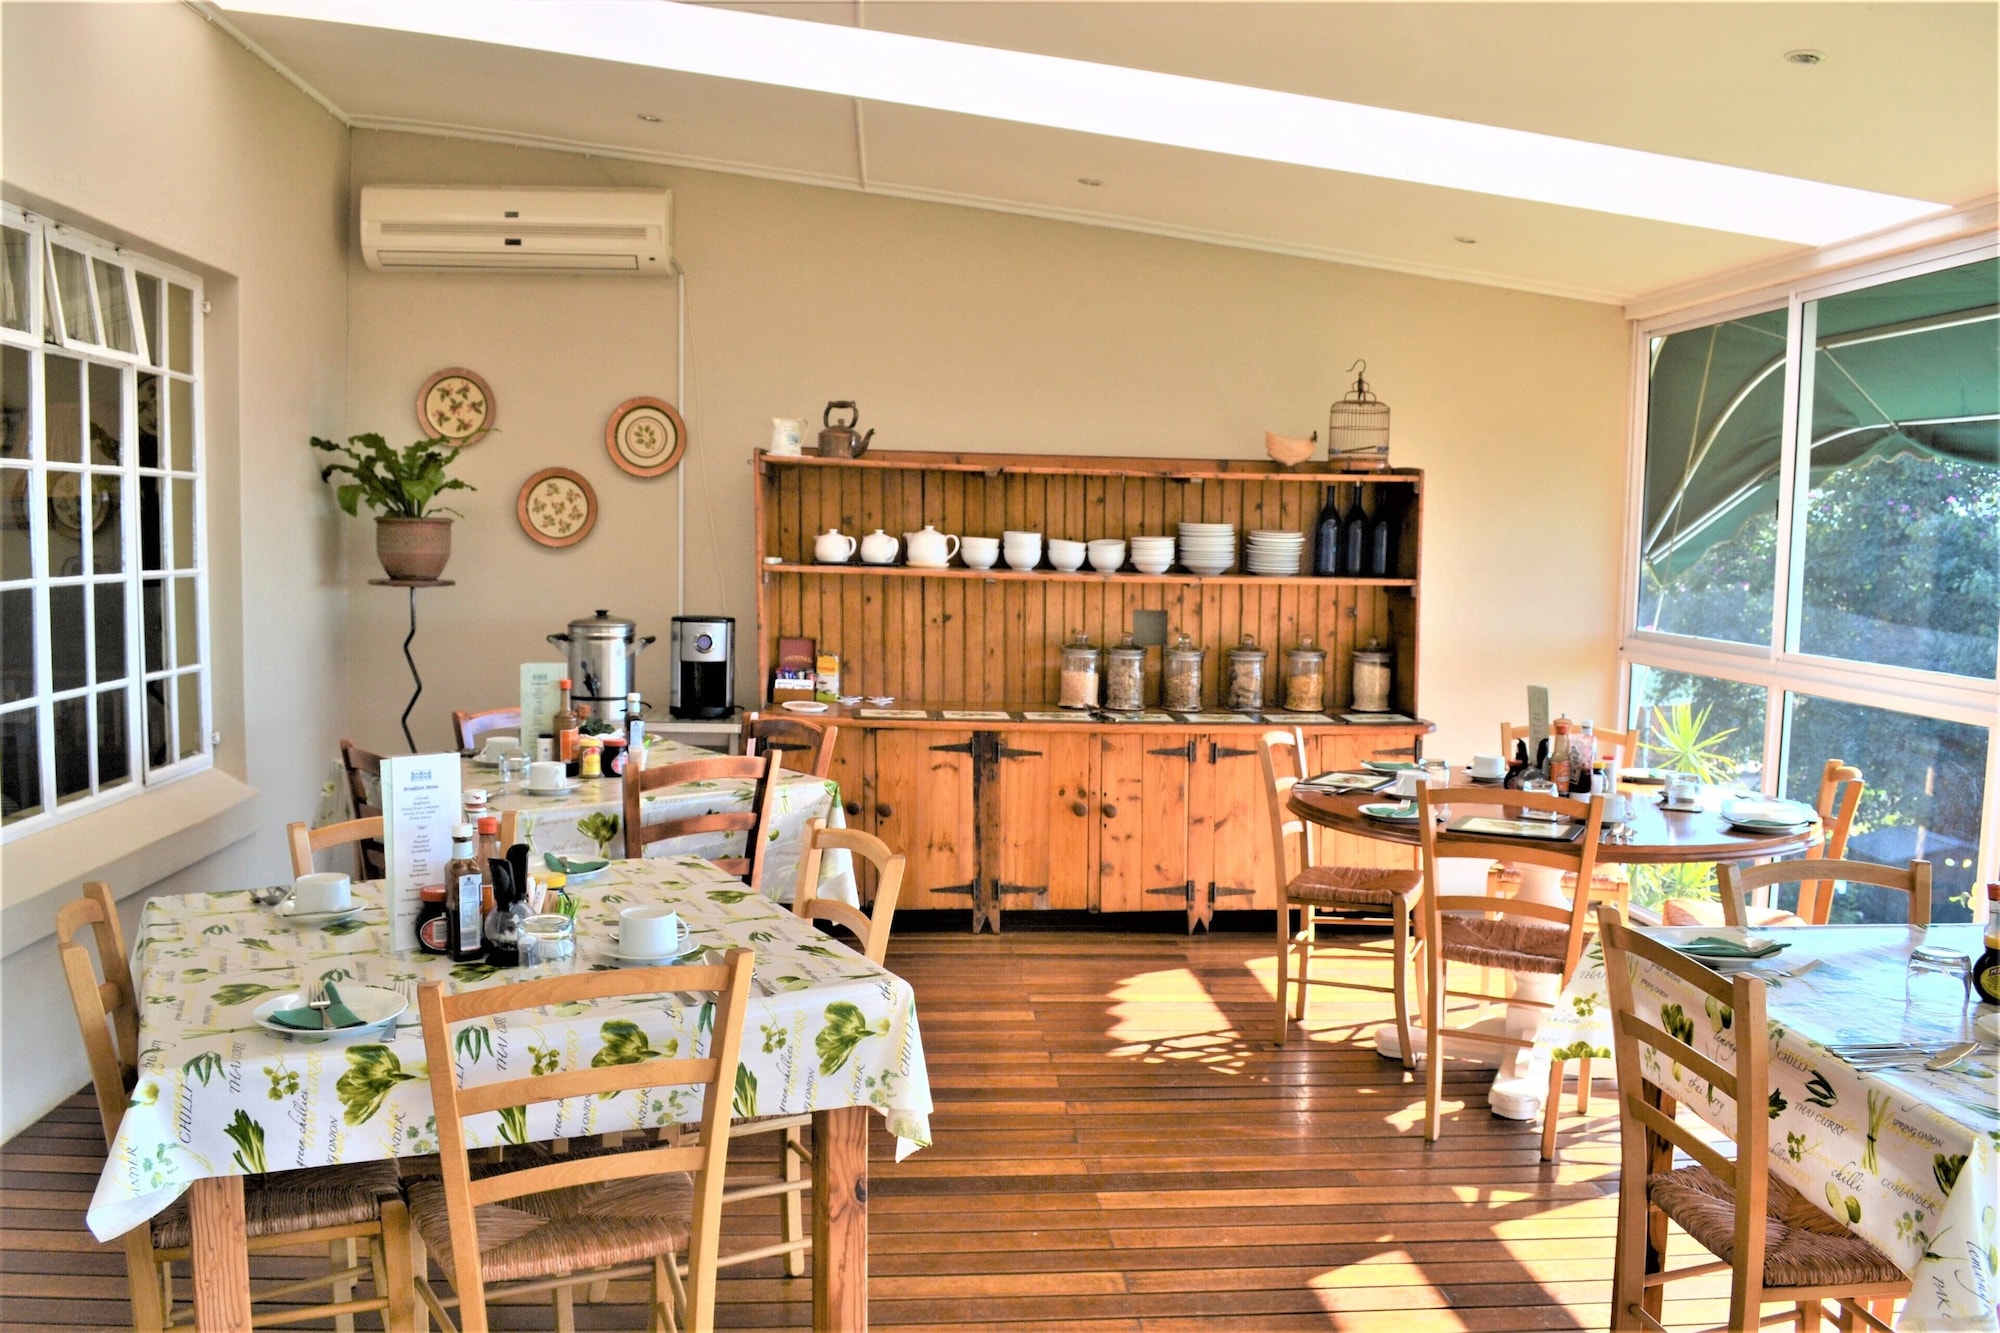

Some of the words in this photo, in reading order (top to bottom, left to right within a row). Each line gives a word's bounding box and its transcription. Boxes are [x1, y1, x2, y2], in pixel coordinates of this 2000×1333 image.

[496, 1036, 508, 1072] THAI
[776, 1044, 793, 1084] chillies
[901, 1022, 913, 1077] CHILLI
[1776, 1051, 1808, 1073] CHILLI
[229, 1060, 242, 1095] THAI
[179, 1083, 193, 1144] CHILLI
[287, 1089, 308, 1134] chillies
[1794, 1101, 1815, 1118] THAI
[1815, 1113, 1848, 1136] CURRY
[328, 1115, 338, 1152] ONION
[392, 1112, 406, 1156] ANDER
[1918, 1131, 1945, 1148] ONION
[130, 1145, 139, 1198] ANDER
[1831, 1161, 1863, 1193] chilli
[1881, 1178, 1936, 1216] CORIANDER
